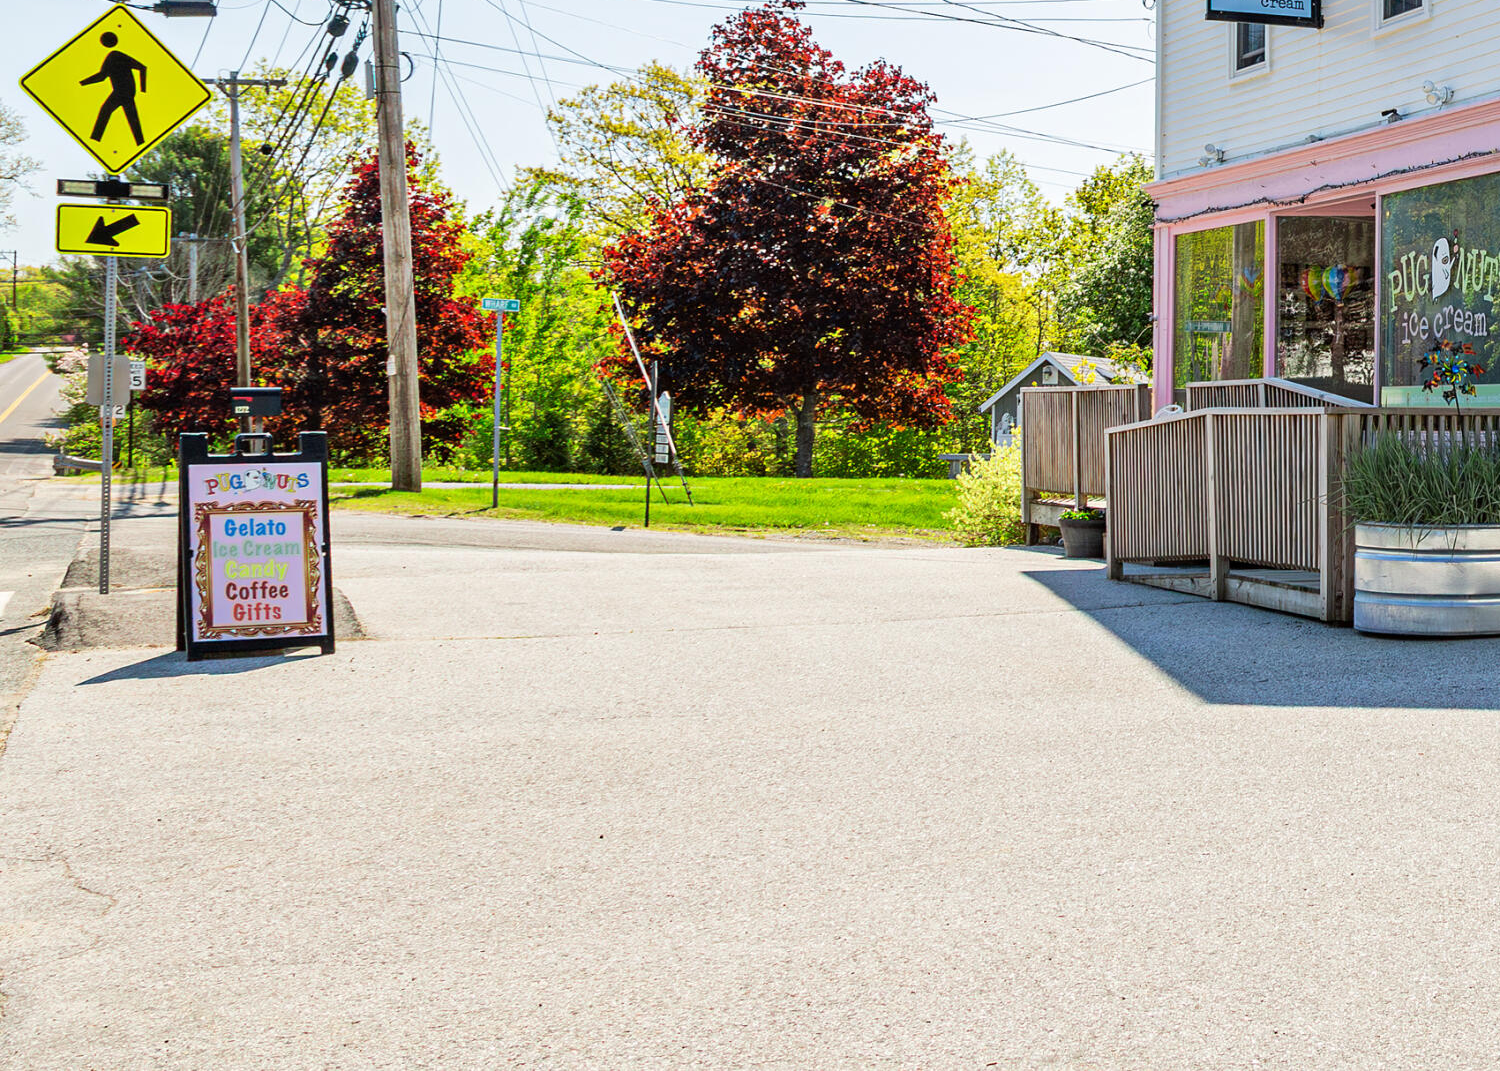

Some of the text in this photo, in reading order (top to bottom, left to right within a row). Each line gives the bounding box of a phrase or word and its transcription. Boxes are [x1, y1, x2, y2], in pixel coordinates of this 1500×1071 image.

[1388, 251, 1430, 313] PUG
[1402, 305, 1488, 344] ice cream
[204, 472, 310, 496] PUG NUTS
[224, 518, 286, 537] Gelato
[212, 540, 300, 558] Ice Cream
[224, 557, 289, 582] Candy
[225, 580, 289, 601] Coffee
[233, 602, 282, 622] Gifts
